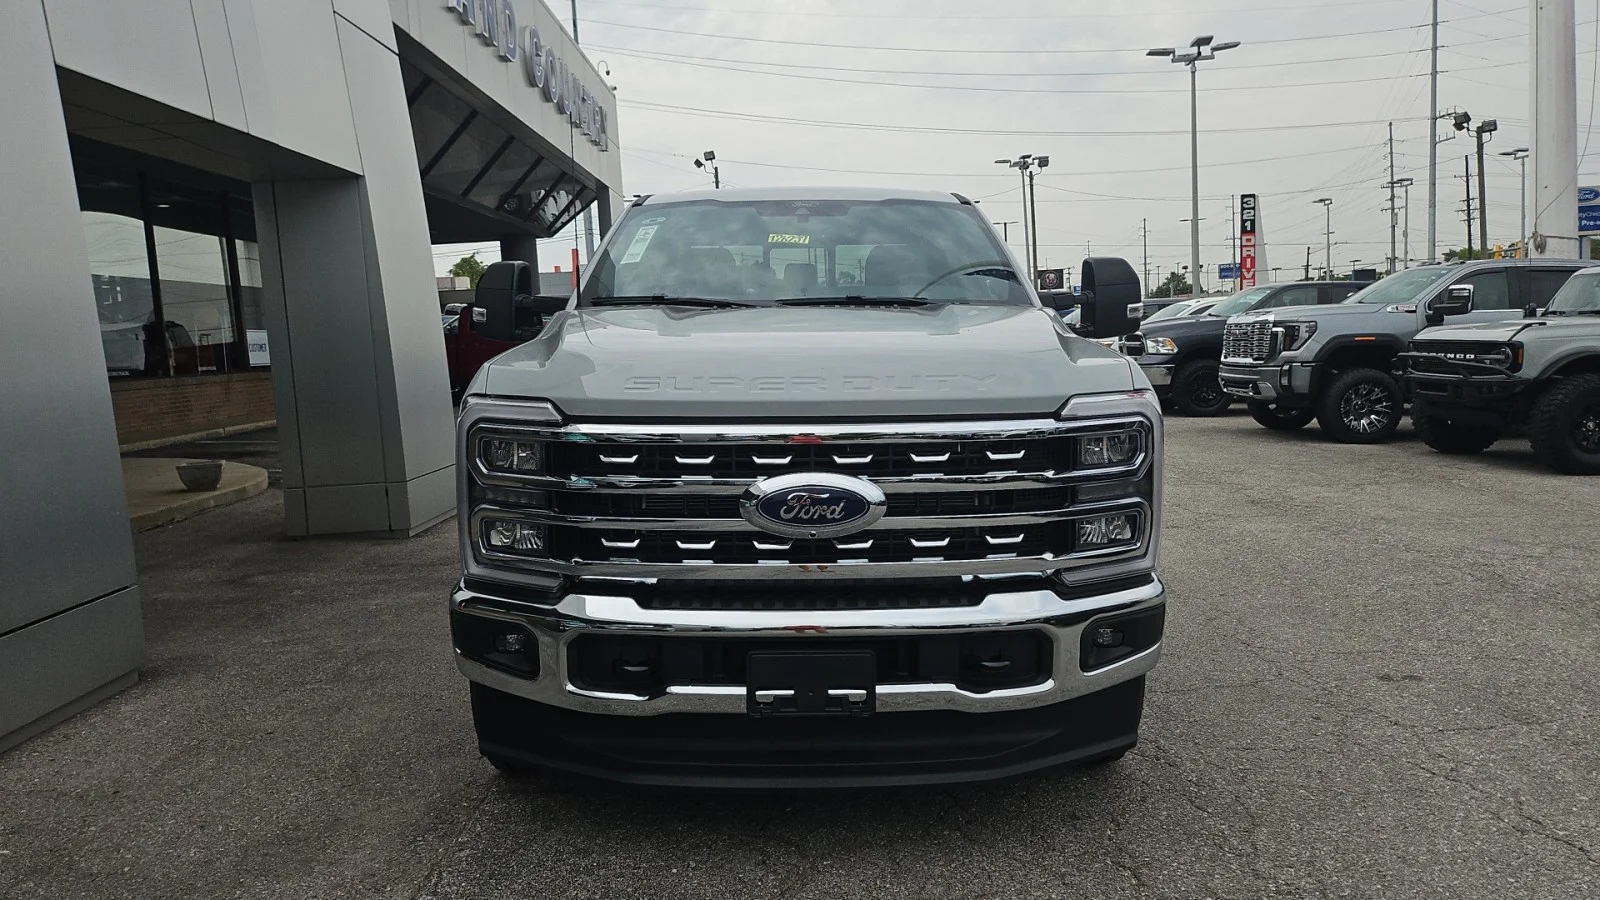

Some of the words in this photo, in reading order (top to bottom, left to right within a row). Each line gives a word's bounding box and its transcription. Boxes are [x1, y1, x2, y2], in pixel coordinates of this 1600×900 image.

[525, 25, 608, 151] COUNTRY
[1242, 197, 1255, 231] 321
[624, 376, 827, 393] SUPER
[843, 374, 997, 392] DUTY
[779, 492, 846, 520] Ford
